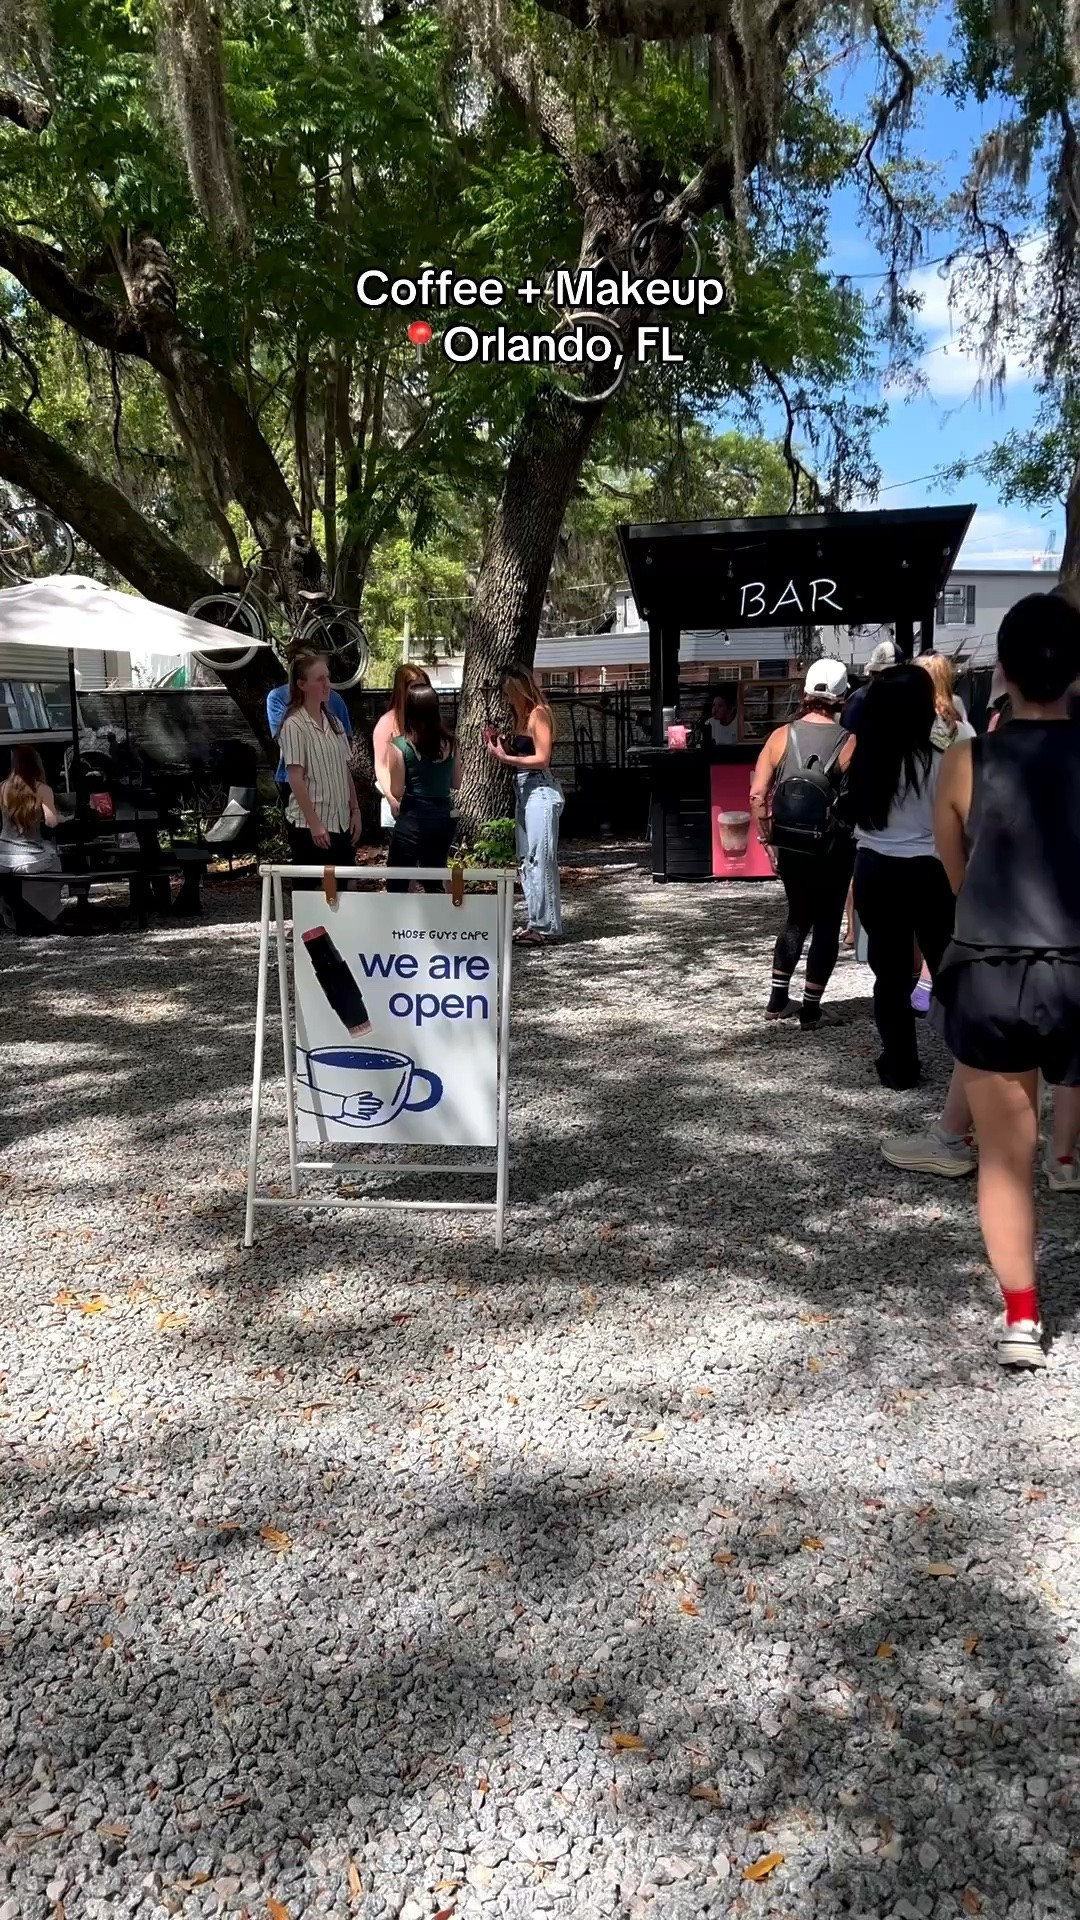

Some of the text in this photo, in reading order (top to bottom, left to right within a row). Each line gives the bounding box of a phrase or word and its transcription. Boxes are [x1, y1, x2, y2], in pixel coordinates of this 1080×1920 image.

[740, 578, 843, 617] BAR
[428, 930, 458, 941] GUYS
[358, 953, 490, 981] we are
[388, 992, 489, 1027] open
